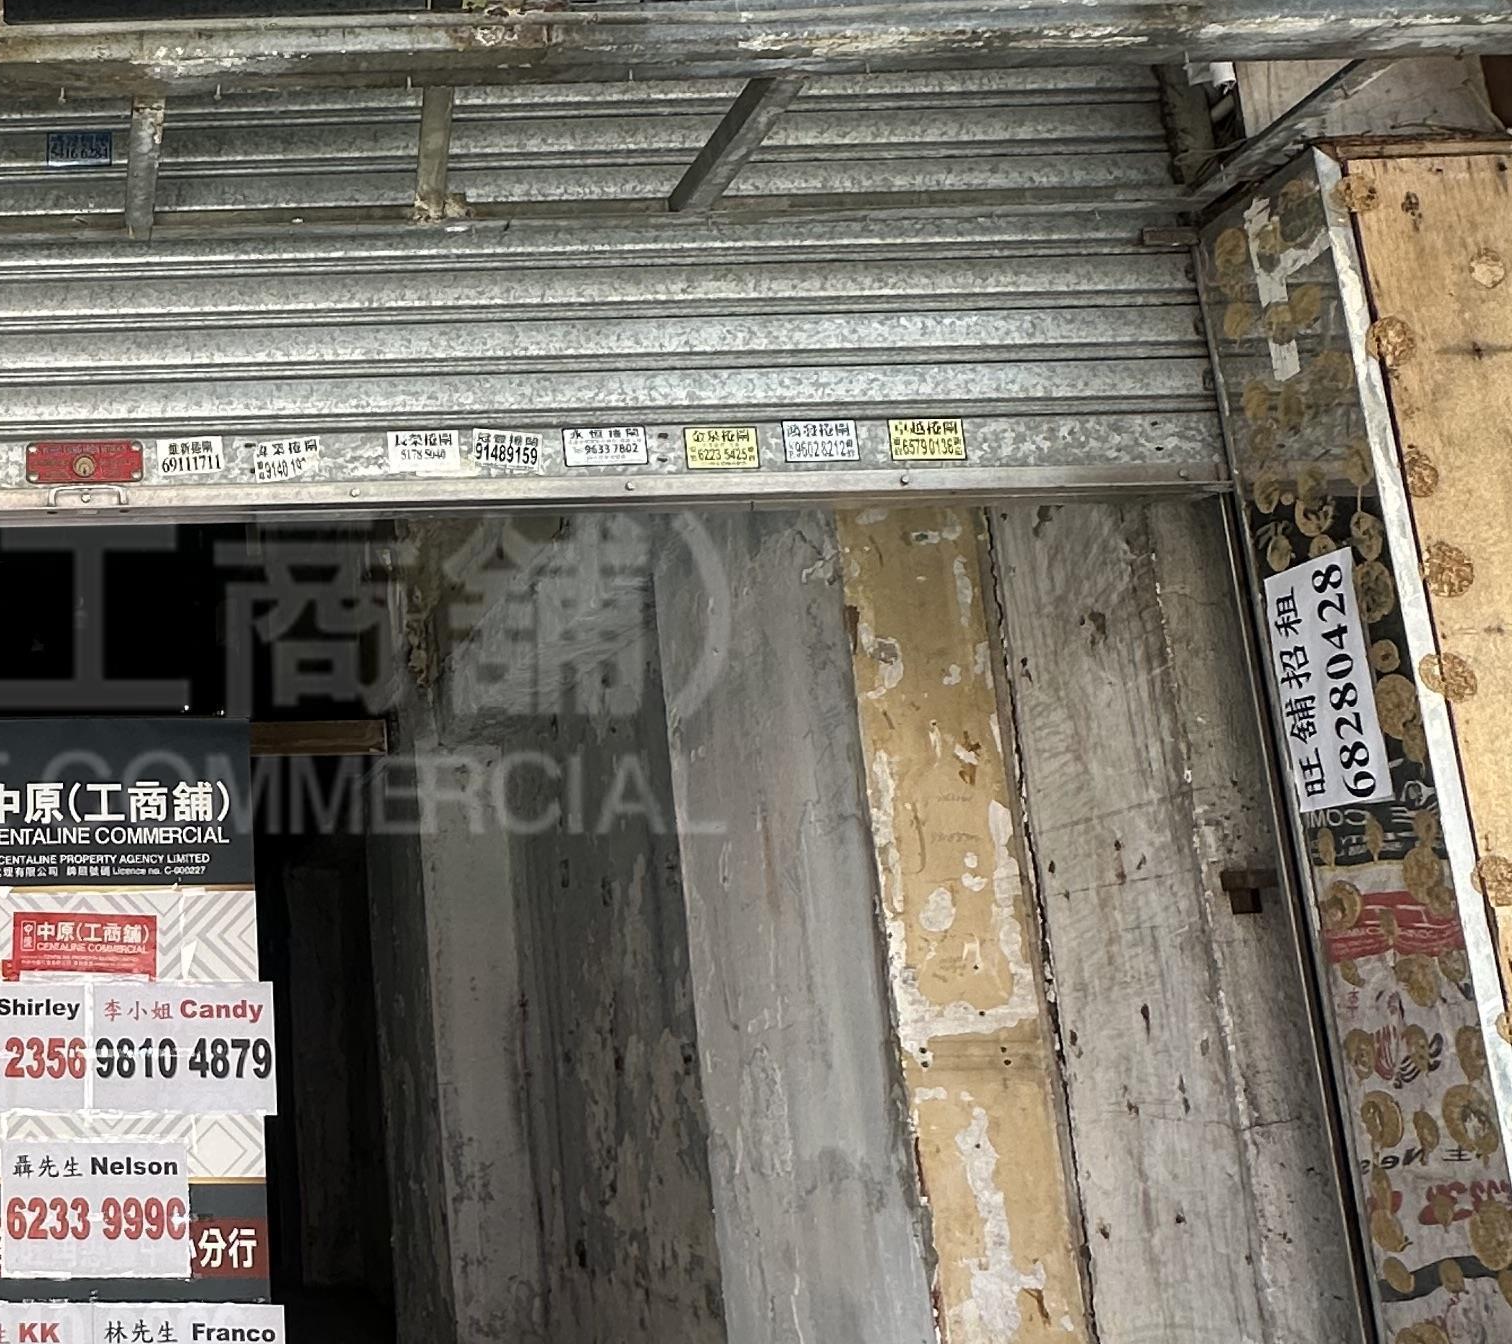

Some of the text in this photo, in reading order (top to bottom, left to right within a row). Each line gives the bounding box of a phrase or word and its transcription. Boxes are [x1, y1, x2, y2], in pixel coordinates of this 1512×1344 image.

[1275, 586, 1325, 797] 旺舖招租
[1312, 563, 1376, 798] 68280428
[95, 826, 230, 845] COMMERCIAL
[60, 855, 117, 864] PROPERTY
[119, 855, 164, 864] AGENCY
[167, 853, 210, 863] LIMITED
[104, 998, 264, 1024] 李小姐 Candy
[188, 1038, 272, 1079] 4879
[12, 1154, 179, 1179] 聶先生 Nelson
[6, 1197, 90, 1241] 6233
[189, 1227, 257, 1269] 分行
[19, 1323, 60, 1343] KK
[104, 1319, 276, 1344] 林先生 Franco
